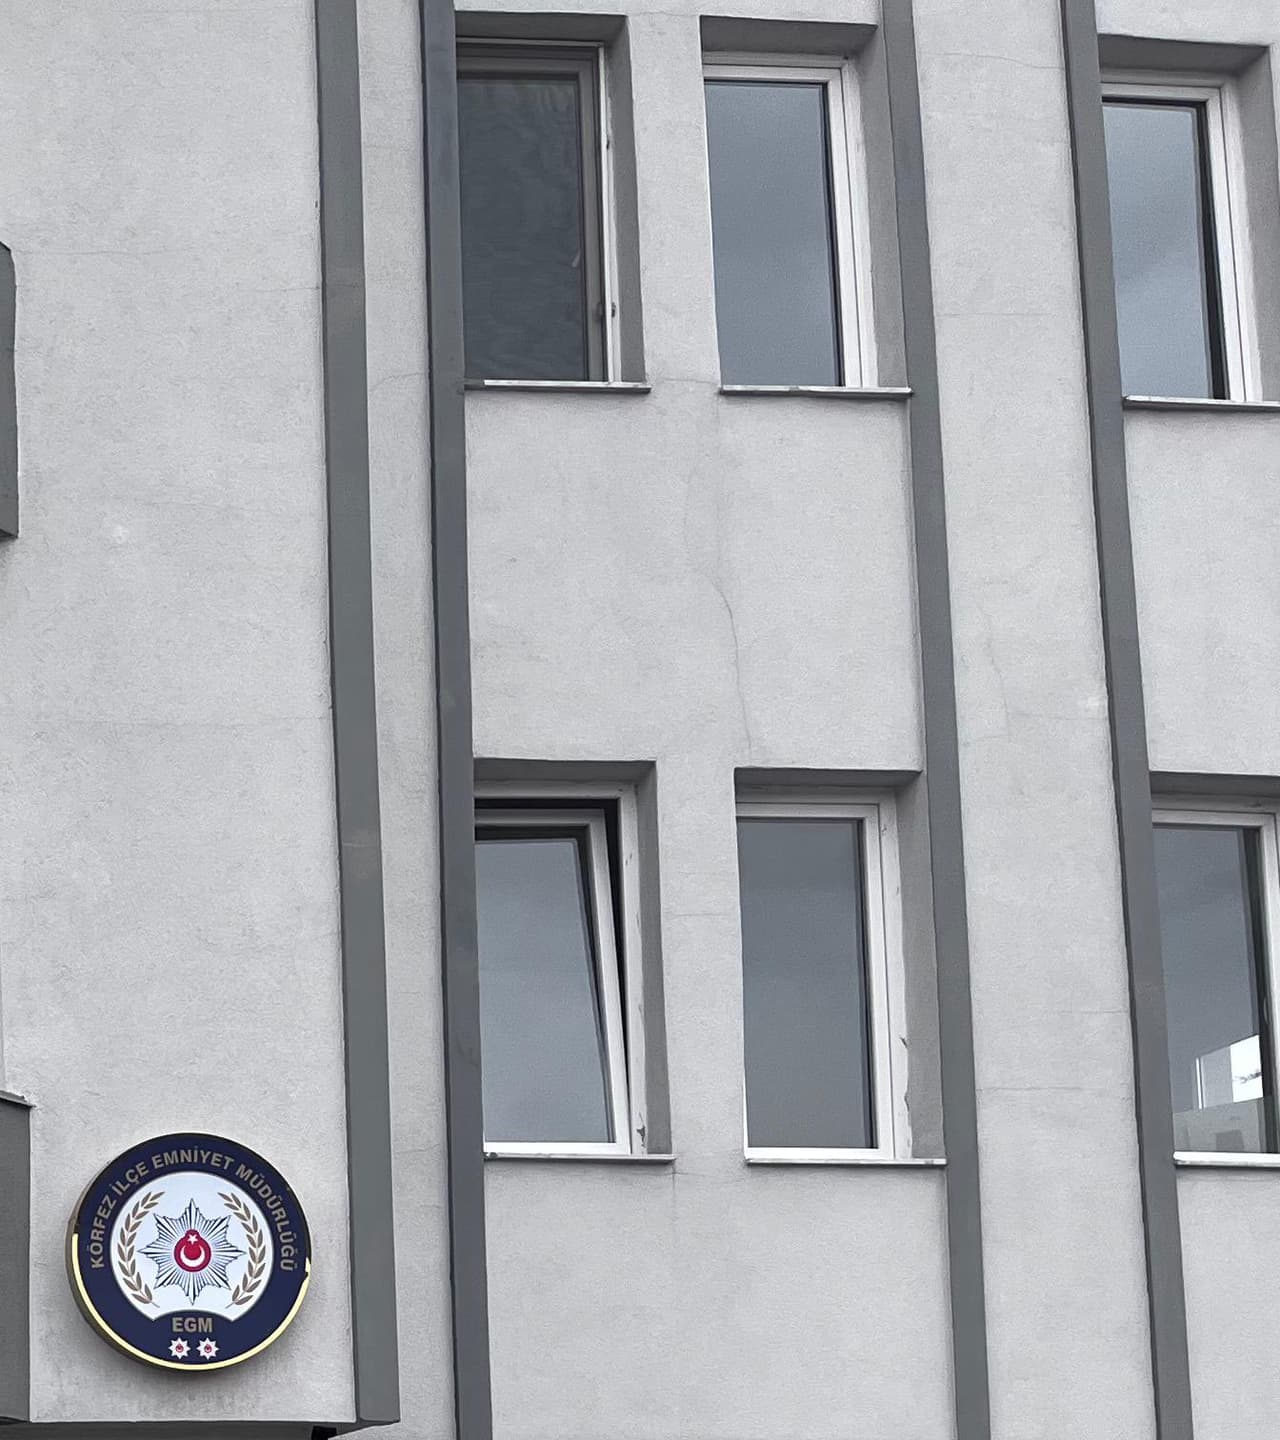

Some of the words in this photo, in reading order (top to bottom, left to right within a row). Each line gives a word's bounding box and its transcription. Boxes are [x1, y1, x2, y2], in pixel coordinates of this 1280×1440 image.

[86, 1194, 117, 1269] KÖRFEZ
[111, 1161, 150, 1197] İLÇE
[151, 1145, 234, 1170] EMNİYET
[236, 1163, 298, 1272] MÜDÜRLÜĞÜ
[171, 1316, 213, 1333] EGM
